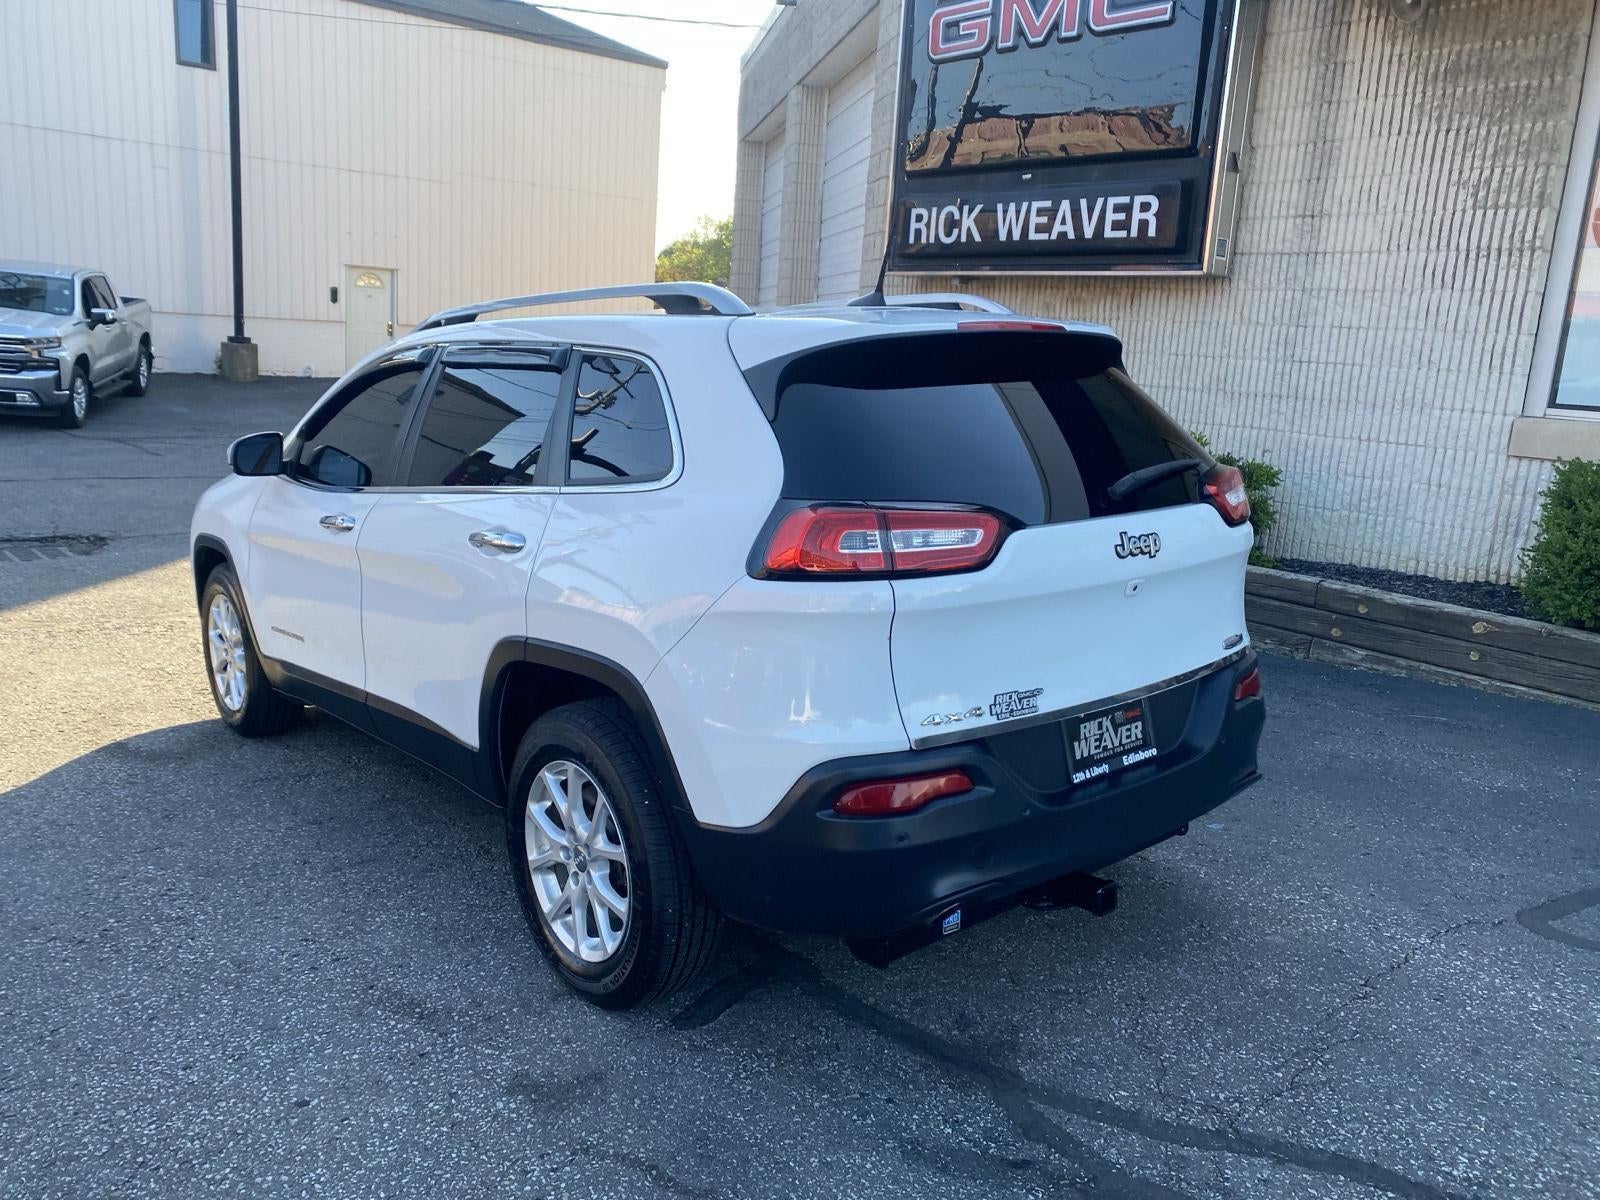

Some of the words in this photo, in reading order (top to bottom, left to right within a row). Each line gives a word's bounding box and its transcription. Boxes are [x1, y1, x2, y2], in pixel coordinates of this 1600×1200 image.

[929, 0, 1173, 59] GMC
[908, 203, 984, 245] RICK
[996, 194, 1160, 242] WEAVER
[1114, 531, 1161, 559] Jeep
[990, 697, 1038, 715] WEAVER
[994, 691, 1019, 705] RICK
[1080, 716, 1111, 739] RICK
[1073, 721, 1143, 760] WEAVER
[1122, 747, 1157, 766] Edinboro
[1072, 771, 1086, 784] 12th
[1090, 763, 1109, 776] Liberty
